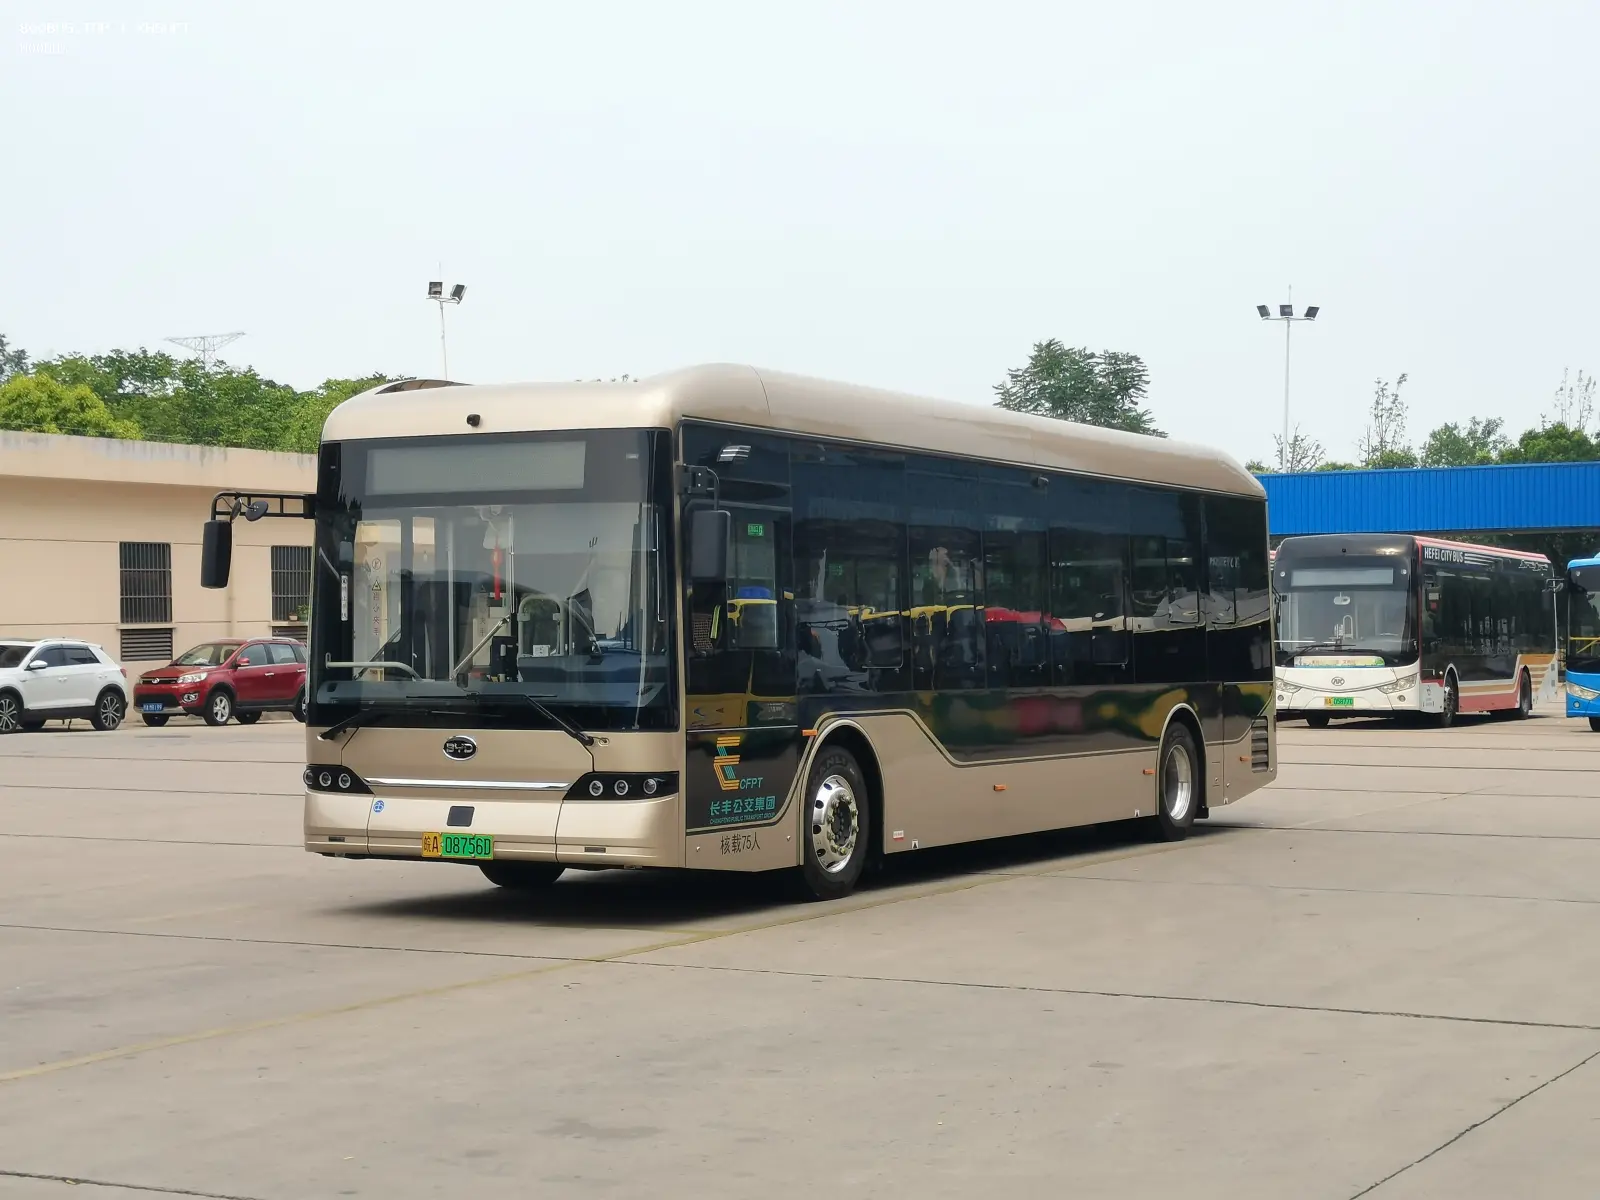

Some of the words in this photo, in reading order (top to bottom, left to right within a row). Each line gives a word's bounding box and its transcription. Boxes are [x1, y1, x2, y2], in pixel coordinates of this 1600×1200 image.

[1424, 547, 1440, 560] HEFEI
[1440, 549, 1452, 562] CITY
[1452, 551, 1464, 563] BUS
[446, 742, 474, 754] BYD
[740, 777, 763, 790] CFPT
[710, 796, 776, 816] 长丰公交集团
[445, 836, 491, 855] 08756D
[720, 832, 761, 855] 核载75人
